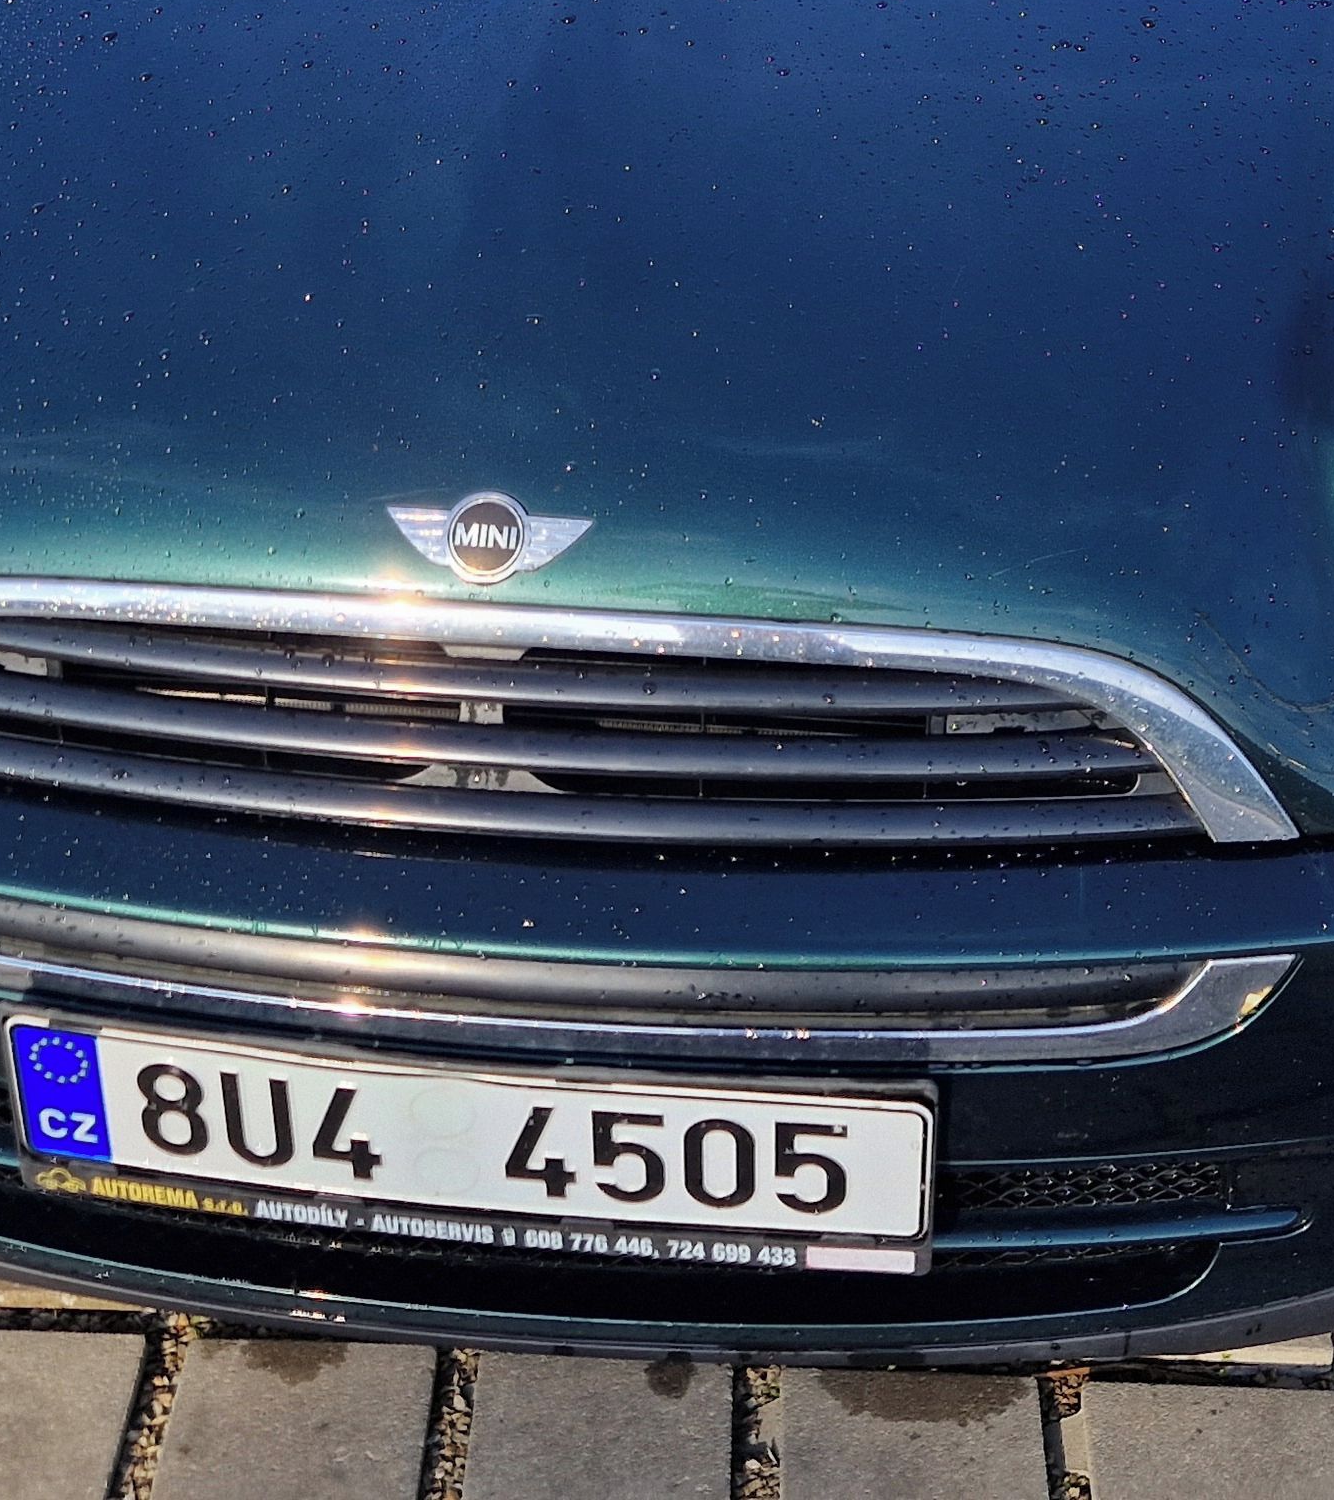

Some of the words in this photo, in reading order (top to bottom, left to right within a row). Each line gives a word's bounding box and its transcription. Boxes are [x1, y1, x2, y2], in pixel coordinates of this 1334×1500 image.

[454, 522, 518, 550] MINI
[38, 1108, 98, 1143] CZ
[136, 1063, 383, 1181] 8U4
[505, 1104, 848, 1214] 4505
[91, 1176, 198, 1208] AUTOREMA
[201, 1197, 248, 1217] s.r.o.
[254, 1199, 349, 1229] AUTODÍLY
[371, 1213, 494, 1245] AUTOSERVIS
[569, 1232, 608, 1255] 776
[667, 1239, 705, 1262] 724
[712, 1241, 751, 1265] 699
[757, 1245, 796, 1268] 433
